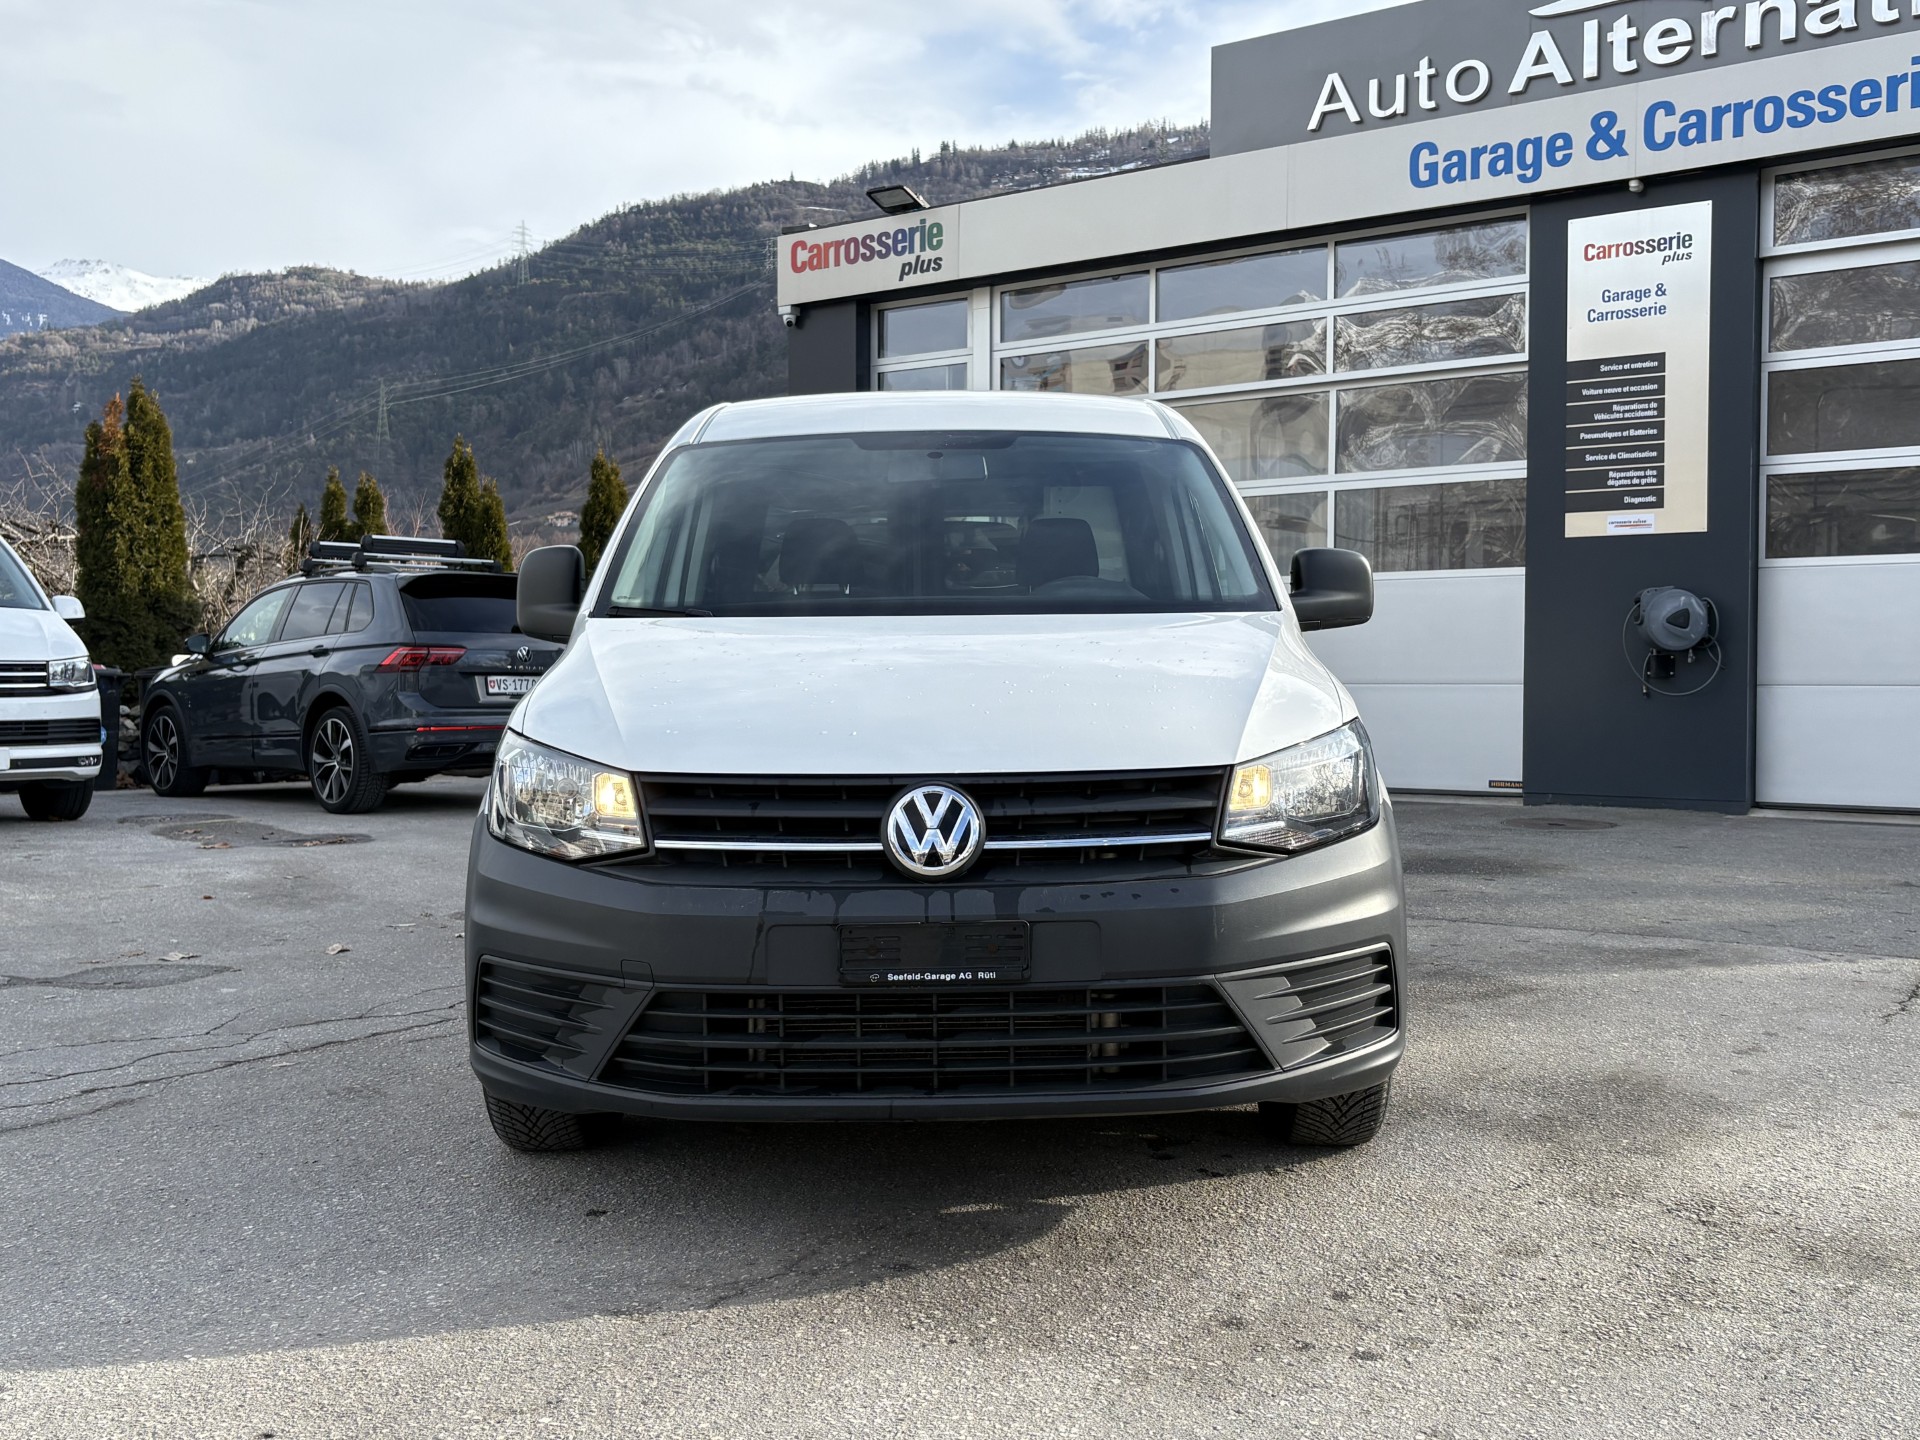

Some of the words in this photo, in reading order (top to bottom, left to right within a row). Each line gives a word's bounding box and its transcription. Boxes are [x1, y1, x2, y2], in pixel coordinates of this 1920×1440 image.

[1306, 55, 1492, 132] Auto
[1507, 0, 1920, 95] Alterna
[1408, 130, 1574, 189] Garage
[1585, 110, 1629, 161] &
[790, 218, 944, 274] Carrosserie
[1583, 231, 1693, 262] Carrosserie
[1661, 251, 1693, 266] plus
[898, 254, 943, 282] plus
[1601, 287, 1652, 303] Garage
[1654, 282, 1667, 297] &
[1587, 302, 1667, 323] Carrosserie
[1600, 363, 1623, 372] Service
[1630, 360, 1658, 369] entretien
[1581, 388, 1603, 396] Voiture
[1629, 383, 1658, 392] occasion
[1612, 402, 1649, 412] Réparations
[1649, 401, 1658, 409] de
[1593, 412, 1624, 420] Véhicules
[1580, 431, 1622, 440] Pneumatiques
[1629, 428, 1658, 437] Batteries
[1585, 454, 1608, 462] Service
[1617, 450, 1658, 460] Climatisation
[1608, 470, 1645, 479] Réparations
[1623, 495, 1657, 505] Diagnostic
[887, 972, 957, 982] Seefeld-Garage
[958, 971, 973, 980] AG
[977, 971, 996, 980] Rüti
